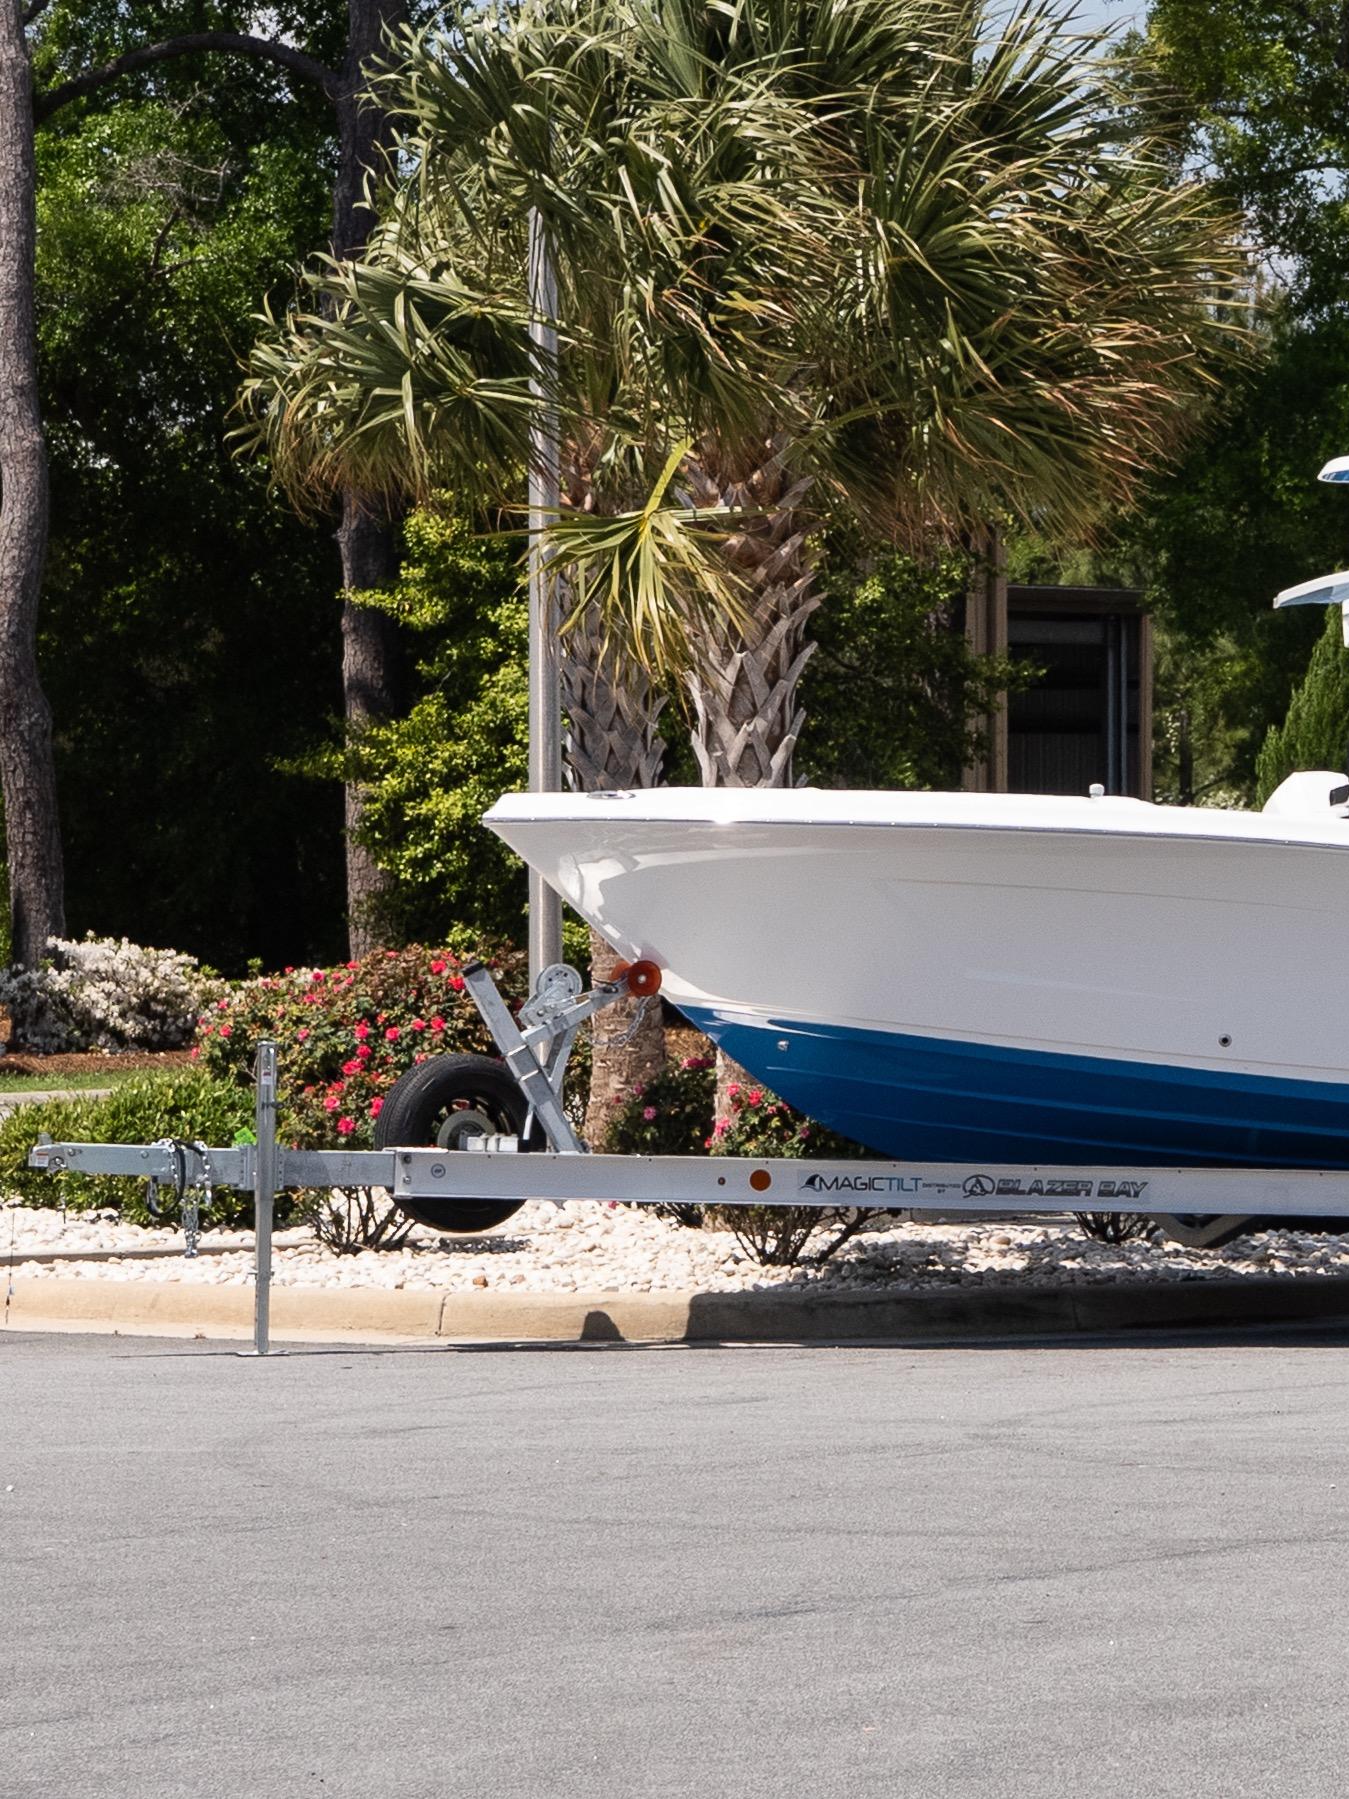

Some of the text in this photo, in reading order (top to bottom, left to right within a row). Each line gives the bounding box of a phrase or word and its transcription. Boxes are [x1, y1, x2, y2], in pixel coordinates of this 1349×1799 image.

[818, 1176, 922, 1192] MAGICTILT
[995, 1178, 1149, 1198] BLAZER BAY
